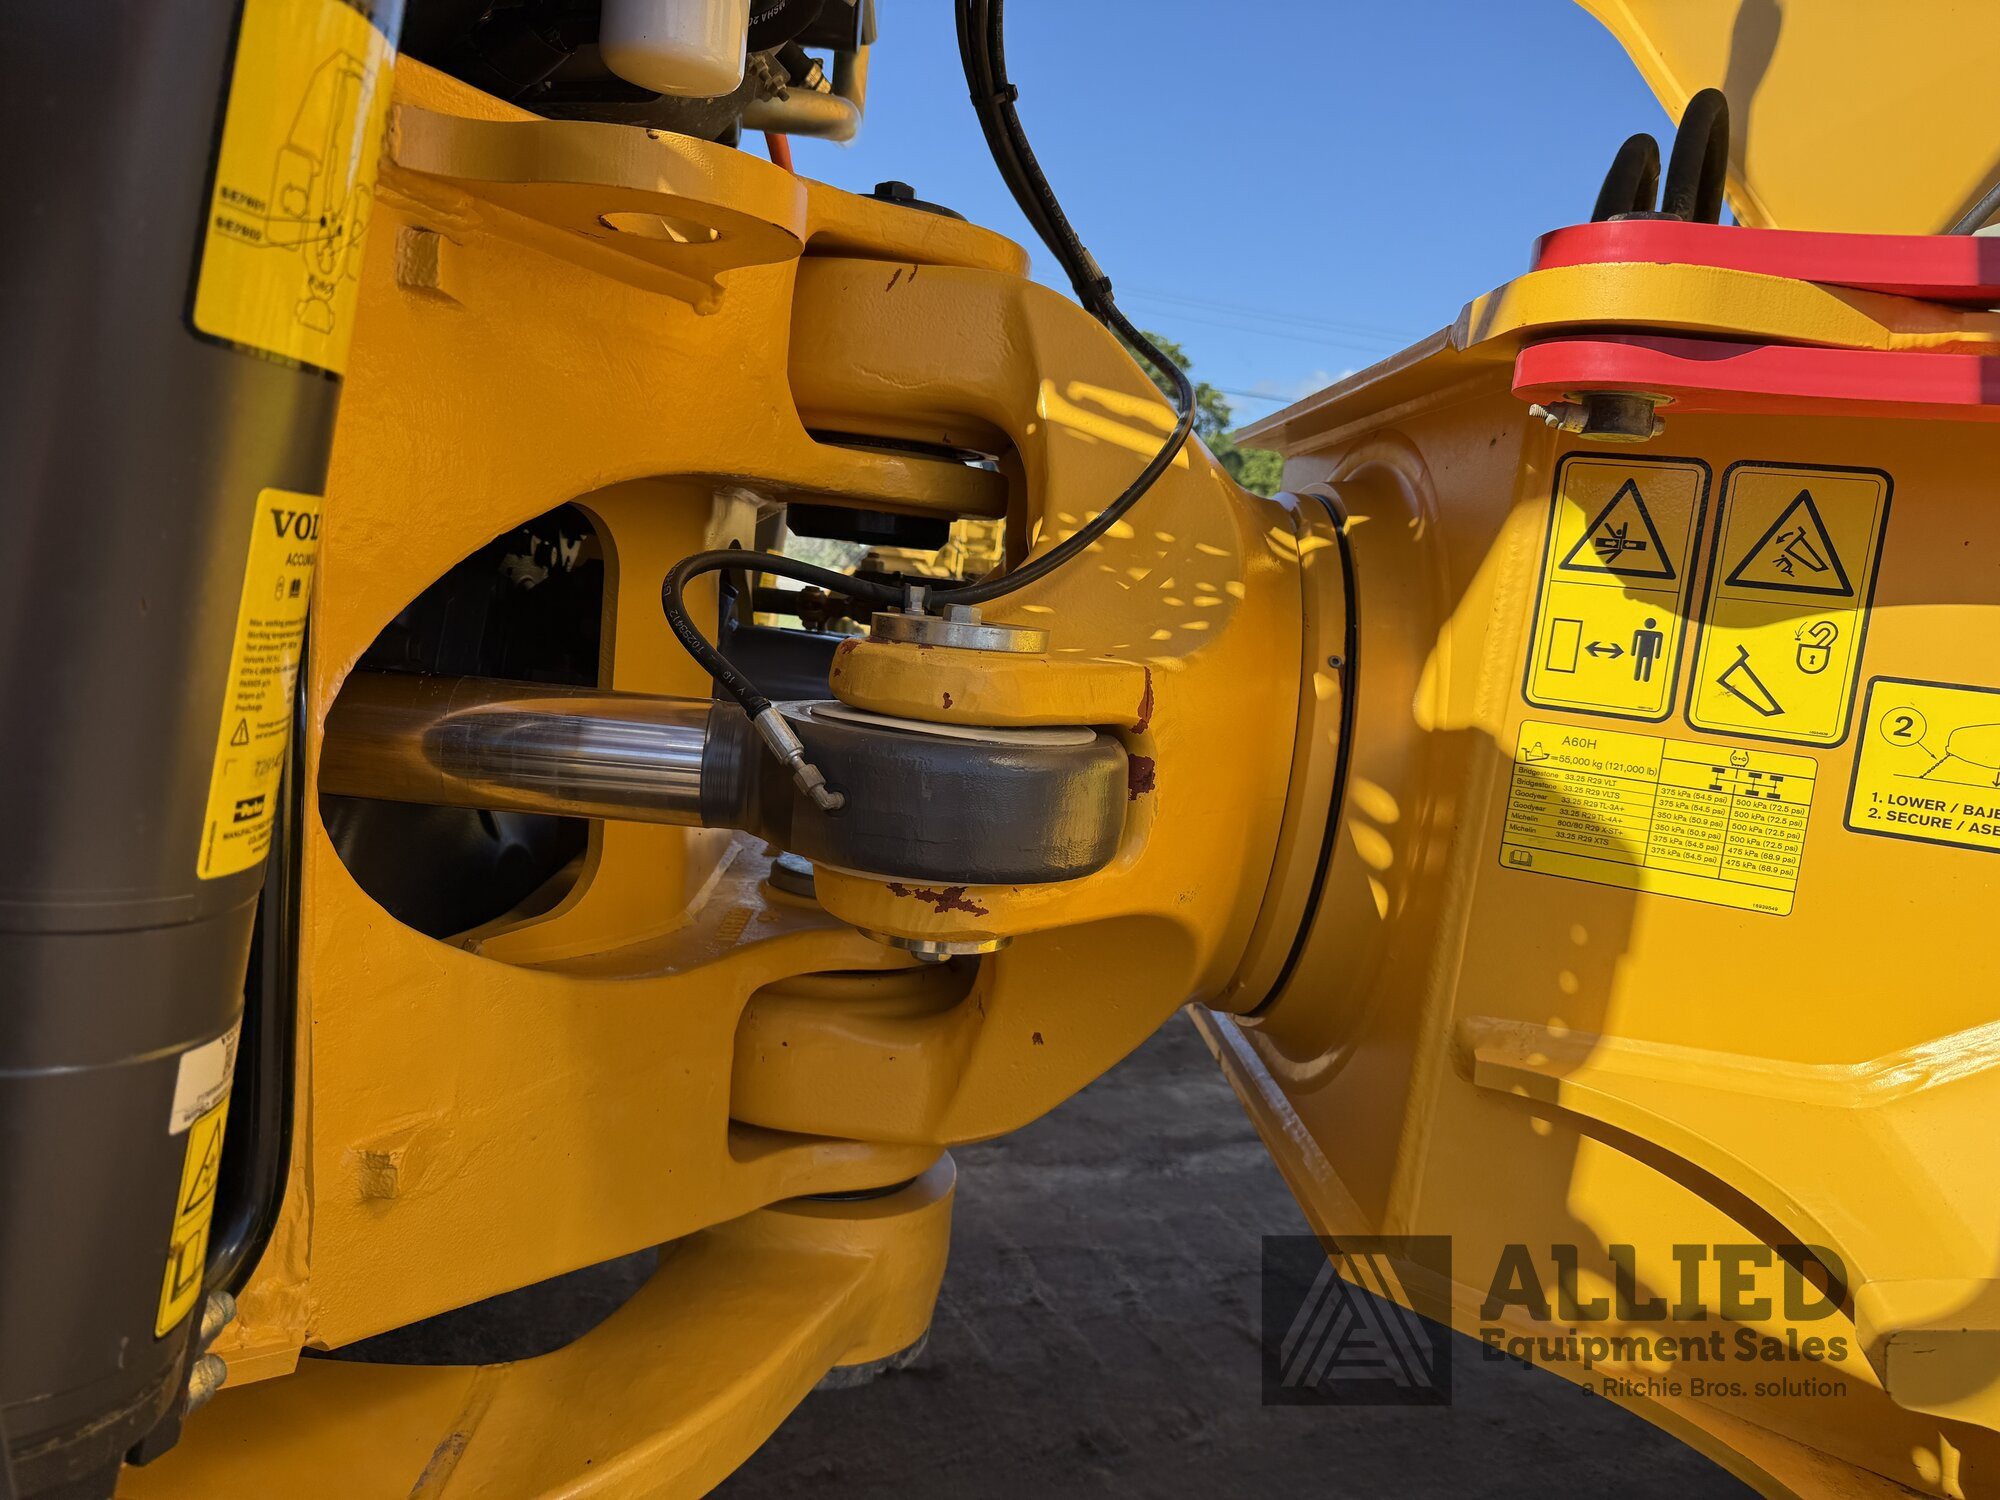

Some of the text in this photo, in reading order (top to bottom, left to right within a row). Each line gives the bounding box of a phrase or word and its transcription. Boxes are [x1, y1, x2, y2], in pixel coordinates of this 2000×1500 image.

[1893, 716, 1914, 738] 2
[1562, 736, 1597, 750] A60H
[1518, 766, 1617, 787] Bridgestone 33.25 R29 VLT
[1592, 760, 1603, 770] kg
[1605, 760, 1645, 775] (121,000
[1647, 767, 1658, 777] lb)
[1516, 778, 1621, 799] Bridgestone 33.25 R29 VLTS
[1661, 788, 1728, 804] 375 kPa (54.5 psi)
[1515, 789, 1548, 801] Goodyear
[1561, 796, 1582, 806] 33.25
[1583, 799, 1598, 808] R29
[1871, 791, 2000, 820] 1. LOWER / BAJE
[1513, 801, 1546, 812] Goodyear
[1559, 808, 1580, 817] 33.25
[1581, 811, 1596, 820] R29
[1659, 800, 1726, 816] 375 kPa (54.5 psi)
[1736, 799, 1805, 816] 500 kPa (72.5 psi)
[1511, 812, 1539, 822] Michelin
[1585, 823, 1600, 831] R29
[1657, 812, 1724, 828] 350 kPa (50.9 psi)
[1734, 811, 1803, 828] 500 kPa (72.5 psi)
[1868, 807, 2000, 836] 2. SECURE / ASE
[1509, 823, 1609, 845] Michelin 33.25 R29 XTS
[1655, 824, 1722, 840] 350 kPa (50.9 psi)
[1732, 823, 1801, 840] 500 kPa (72.5 psi)
[1653, 835, 1720, 852] 375 kPa (54.5 psi)
[1730, 835, 1799, 852] 500 kPa (72.5 psi)
[1651, 847, 1718, 863] 375 kPa (54.5 psi)
[1728, 847, 1797, 864] 475 kPa (68.9 psi)
[1726, 859, 1795, 876] 475 kPa (68.9 psi)
